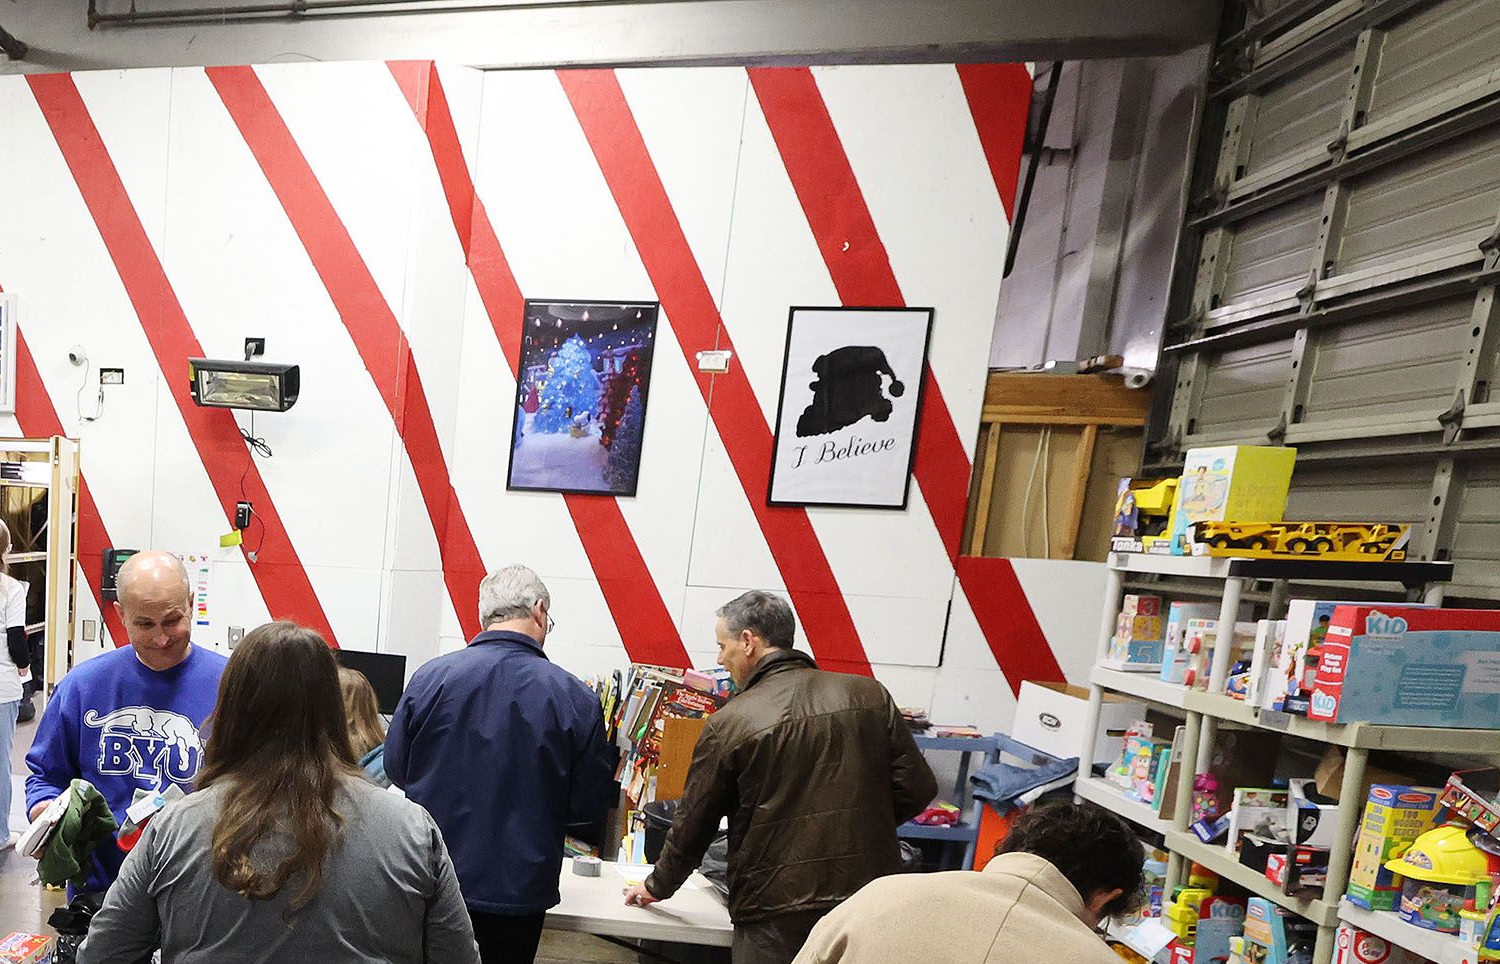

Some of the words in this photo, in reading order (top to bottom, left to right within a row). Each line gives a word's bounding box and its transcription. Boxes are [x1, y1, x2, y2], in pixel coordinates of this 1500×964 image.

[791, 444, 808, 469] I
[814, 436, 895, 464] Believe
[1113, 540, 1143, 551] Tonka
[1367, 616, 1406, 635] KID
[1313, 694, 1336, 711] KID
[98, 734, 203, 783] BYU
